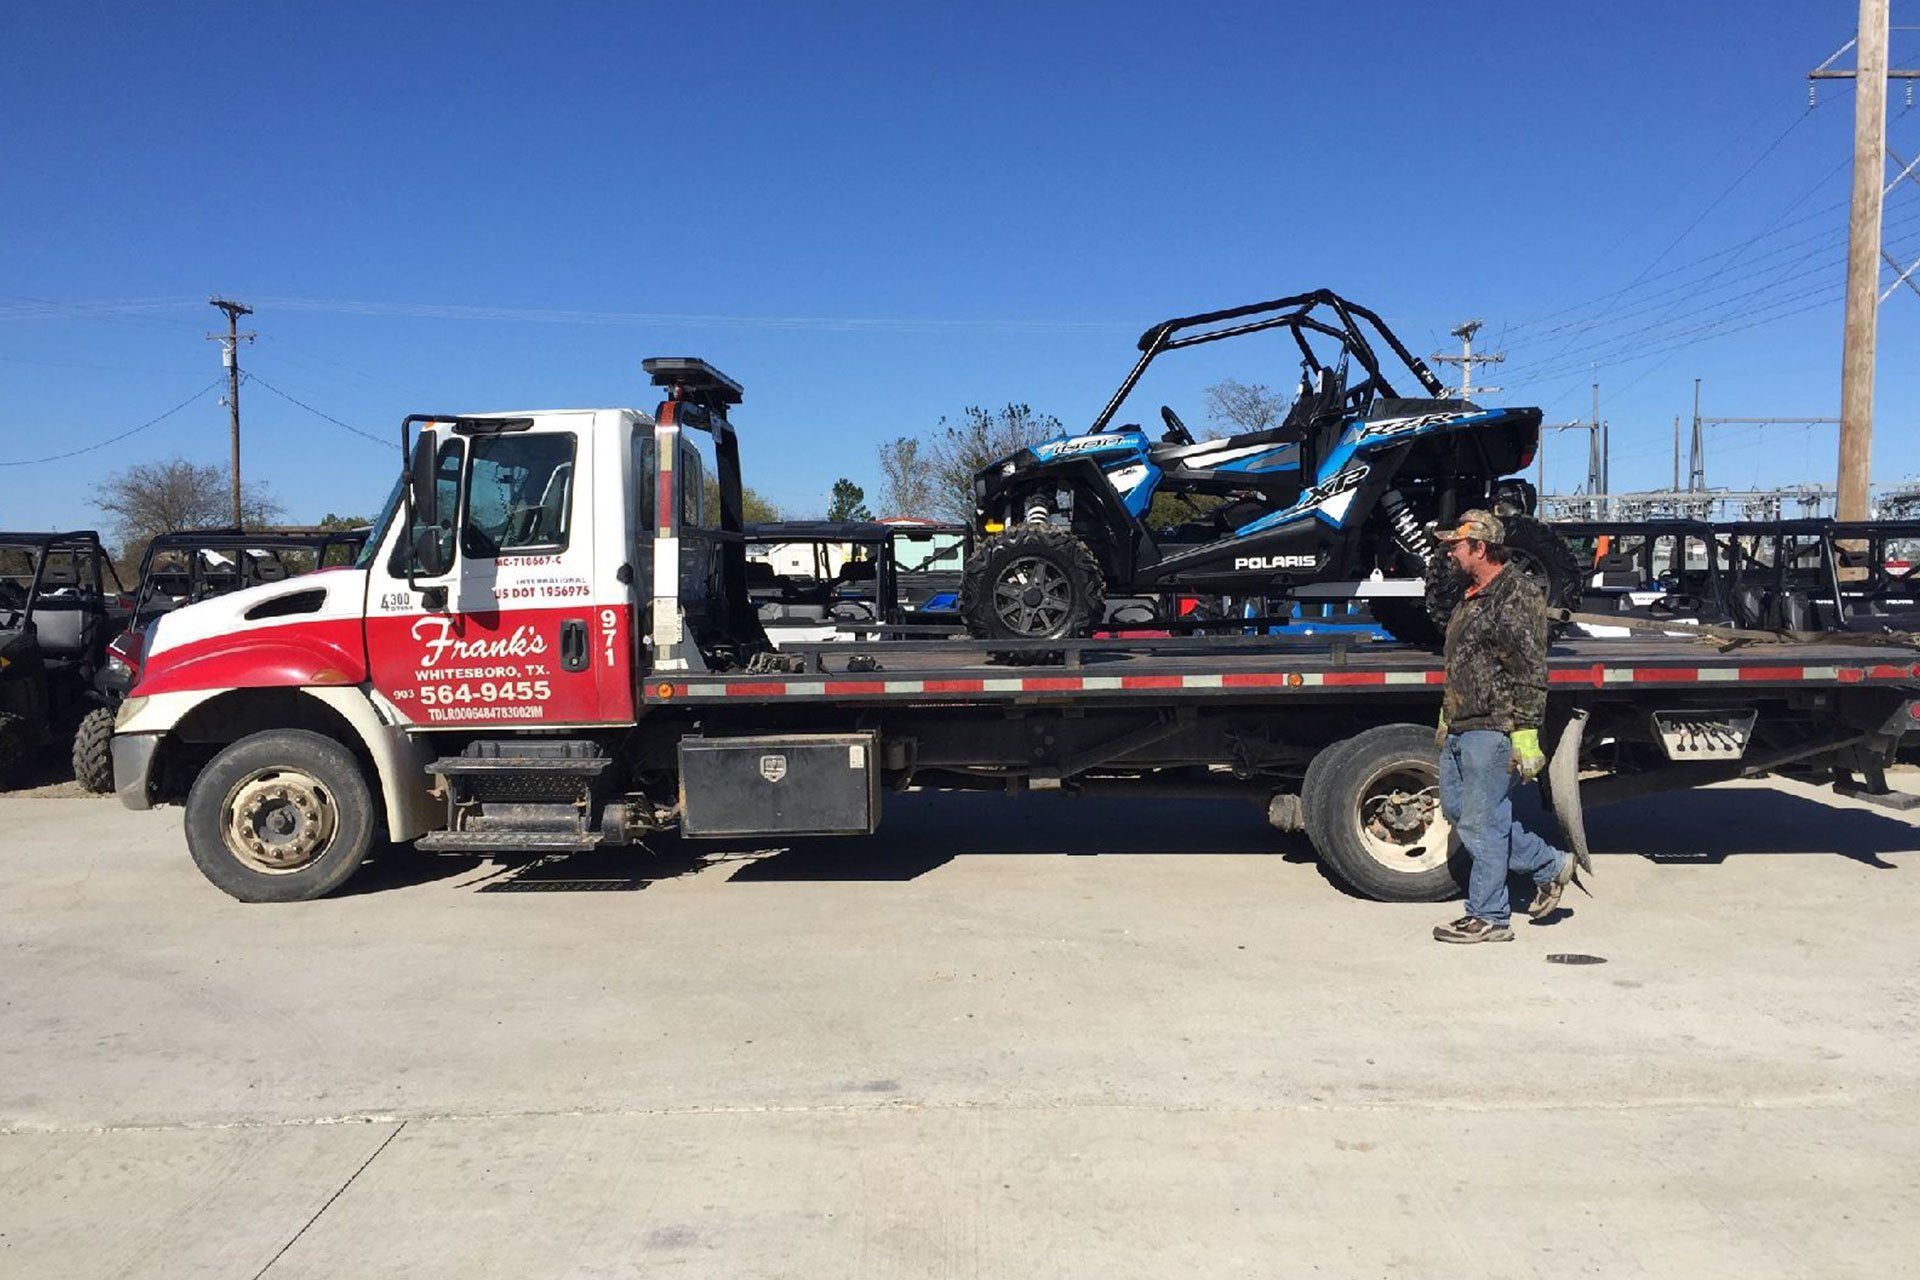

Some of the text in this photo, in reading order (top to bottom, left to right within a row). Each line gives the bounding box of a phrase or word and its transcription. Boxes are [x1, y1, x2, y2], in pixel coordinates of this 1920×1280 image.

[1297, 465, 1371, 508] XP
[1234, 555, 1317, 570] POLARIS
[381, 592, 410, 611] 4300
[494, 588, 509, 600] US
[512, 587, 535, 598] DOT
[411, 616, 548, 667] Frank's
[415, 664, 551, 681] WHITESBORO, TX.
[393, 680, 552, 705] 903 564-9455
